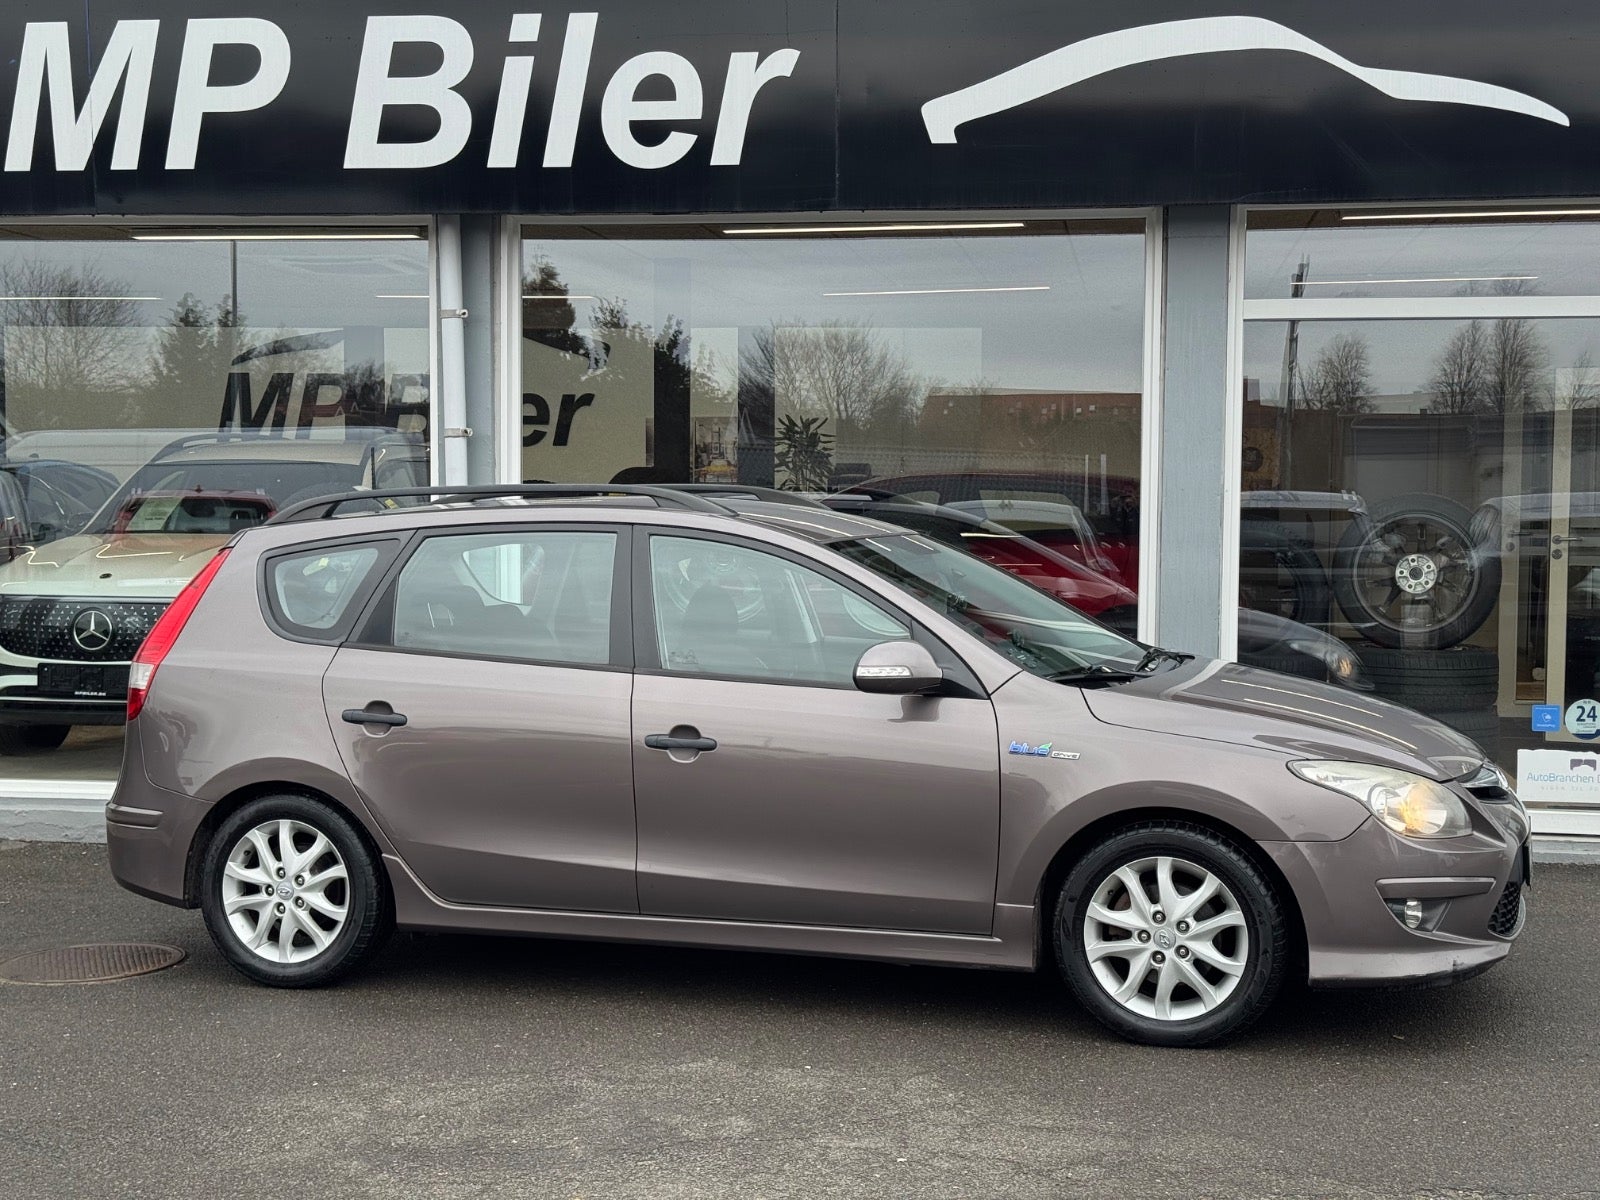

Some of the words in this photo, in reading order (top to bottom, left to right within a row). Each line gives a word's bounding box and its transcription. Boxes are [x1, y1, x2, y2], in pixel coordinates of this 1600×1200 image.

[5, 18, 292, 171] MP
[344, 12, 801, 169] Biler
[1576, 705, 1598, 723] 24
[1009, 741, 1050, 756] blue
[1527, 772, 1594, 784] AutoBranchen
